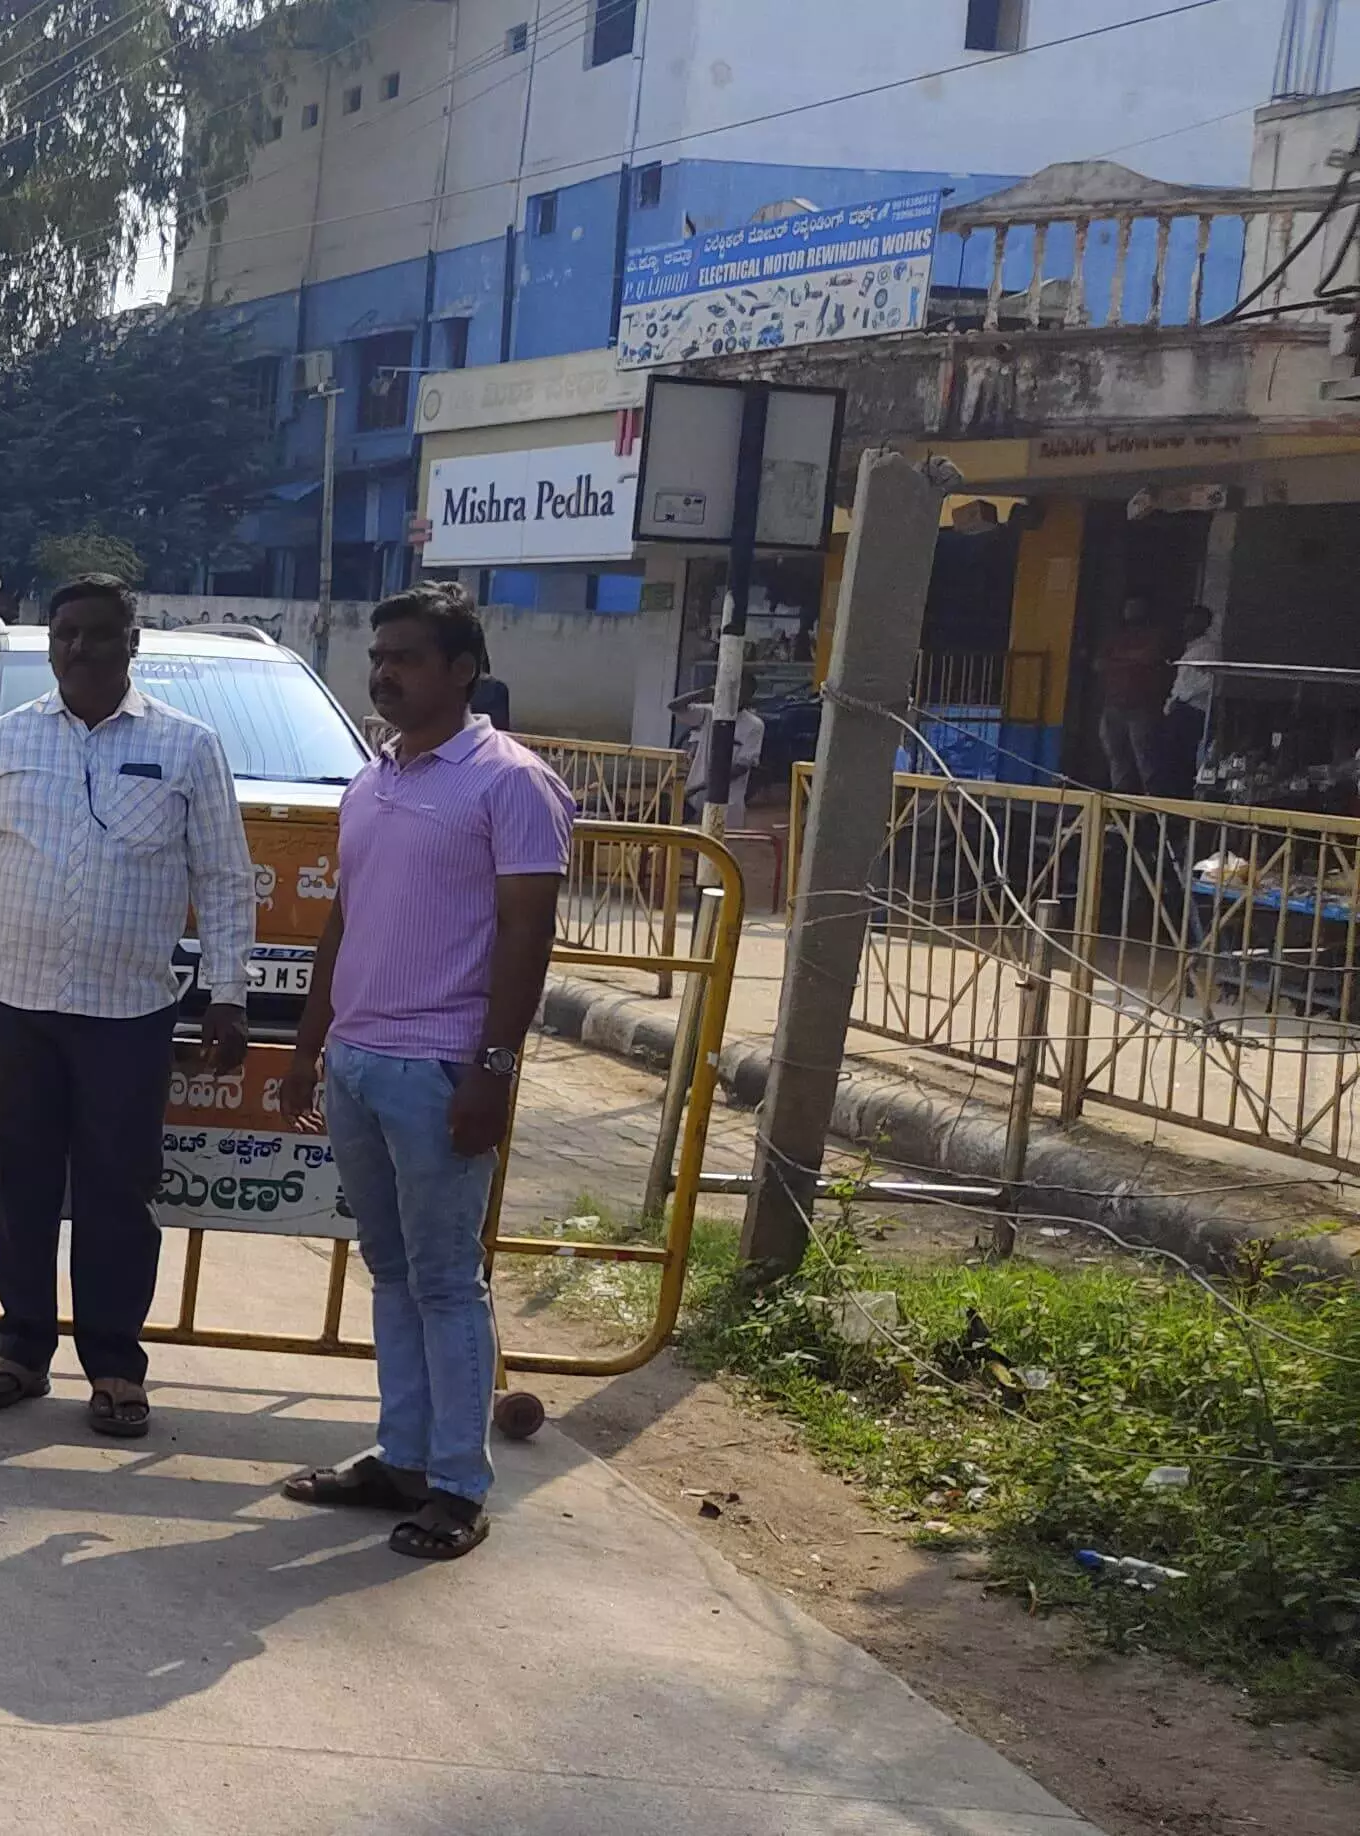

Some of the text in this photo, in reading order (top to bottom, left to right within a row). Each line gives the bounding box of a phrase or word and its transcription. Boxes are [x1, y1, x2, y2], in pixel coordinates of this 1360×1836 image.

[698, 228, 932, 287] ELECTRICAL MOTOR REWINDING WORKS
[442, 474, 615, 526] Mishra Pedha
